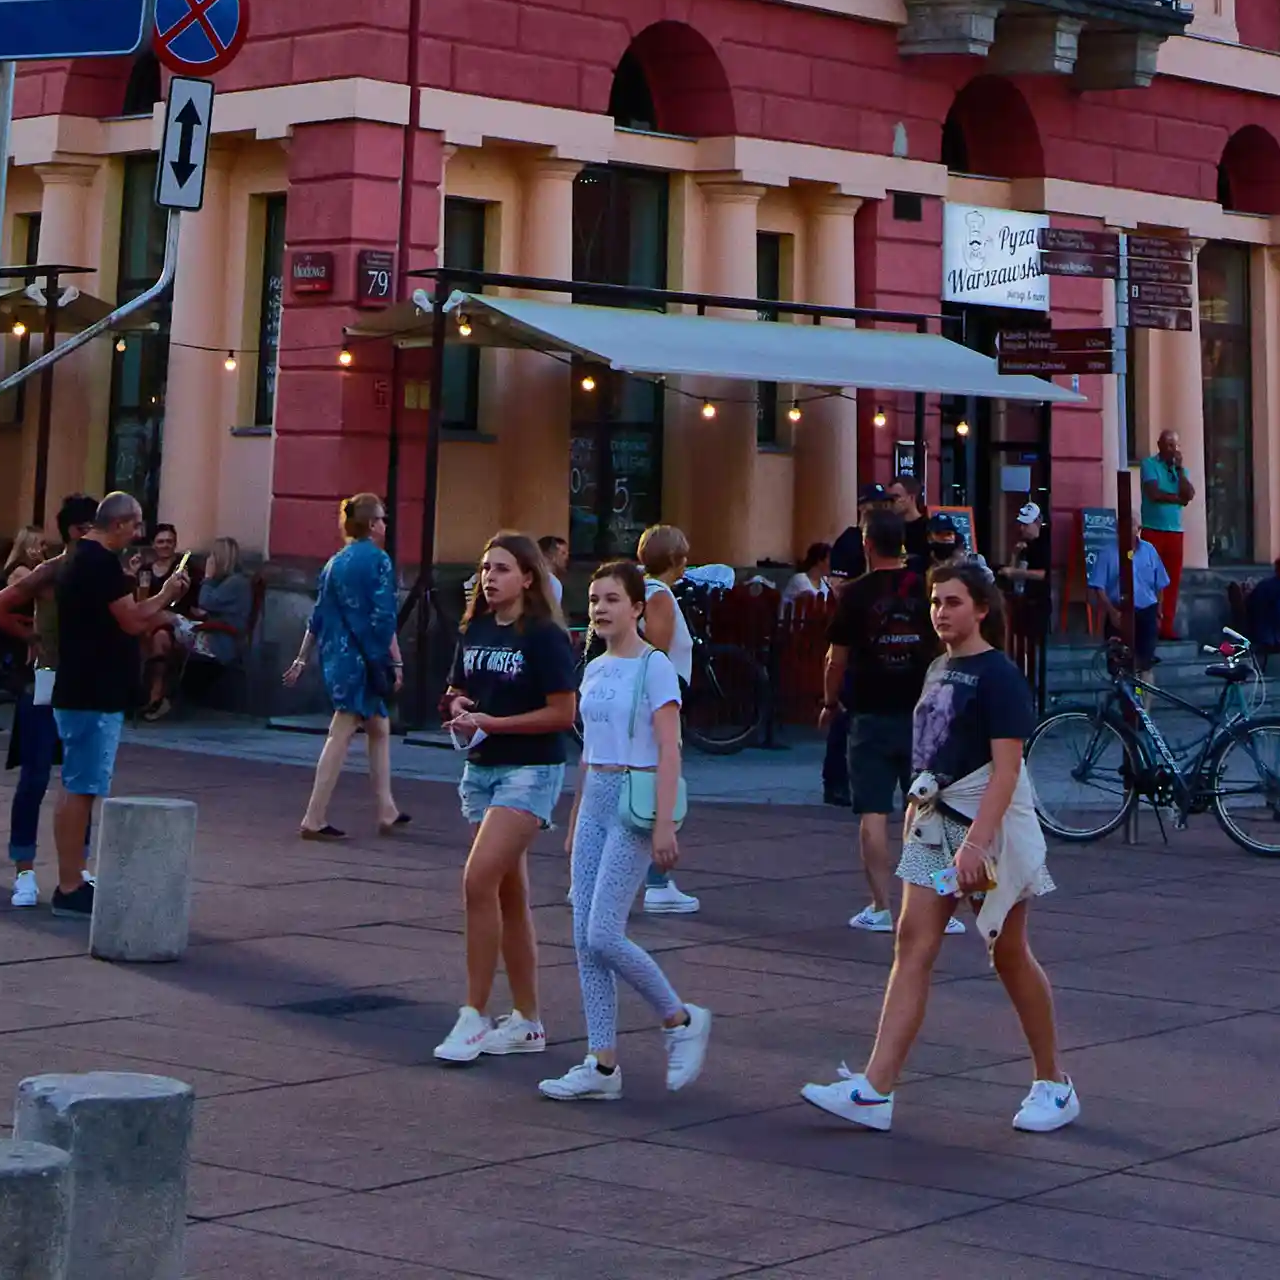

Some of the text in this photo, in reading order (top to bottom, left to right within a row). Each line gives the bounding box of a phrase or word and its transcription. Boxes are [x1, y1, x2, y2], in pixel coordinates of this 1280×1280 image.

[999, 225, 1035, 256] Pyza
[367, 270, 389, 296] 79
[947, 256, 1044, 294] Warszawsk
